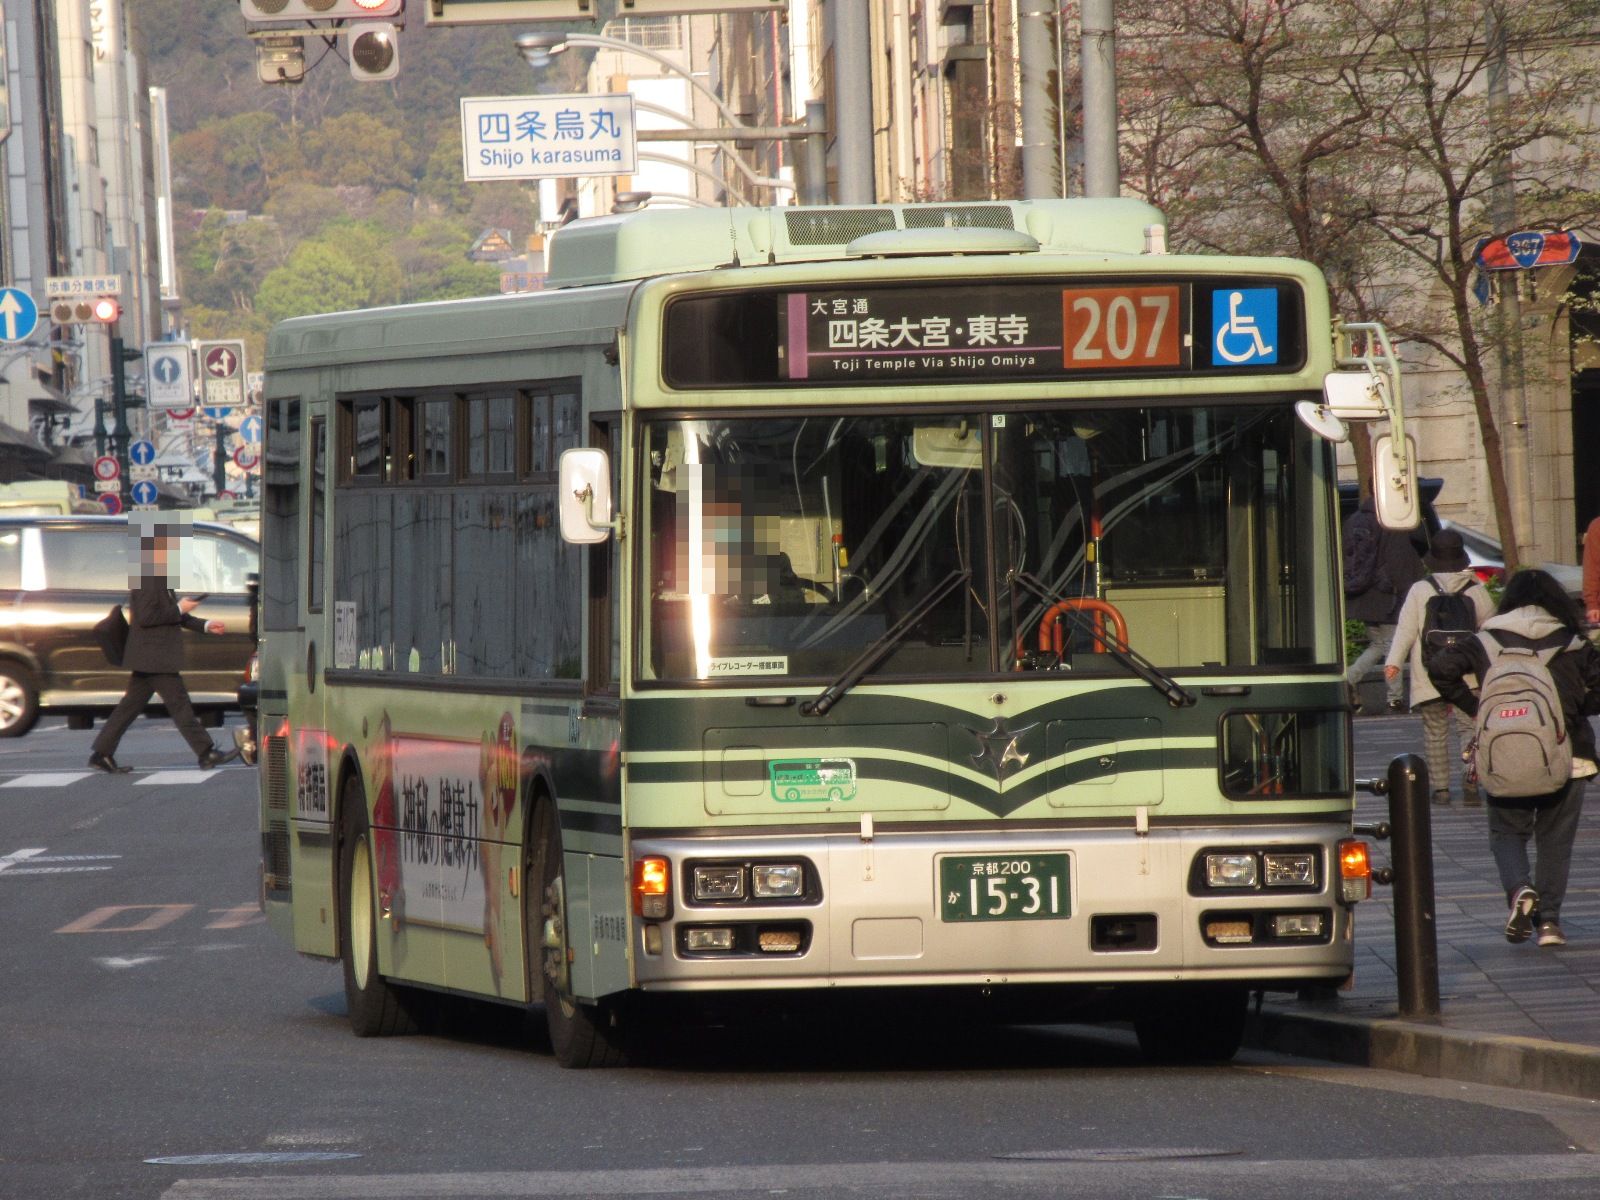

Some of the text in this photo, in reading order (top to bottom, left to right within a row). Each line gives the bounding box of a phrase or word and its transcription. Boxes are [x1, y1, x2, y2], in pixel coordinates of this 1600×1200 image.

[478, 108, 621, 143] 四条烏丸
[480, 148, 621, 168] Shijo karasuma
[811, 298, 869, 316] 大宮通
[828, 313, 1029, 349] 四条大宮・東寺
[1072, 295, 1170, 360] 207
[833, 355, 1035, 372] Toji Temple Via Shijo Omiya
[402, 773, 478, 901] 神秘の健康力
[948, 876, 1058, 916] か 15-31
